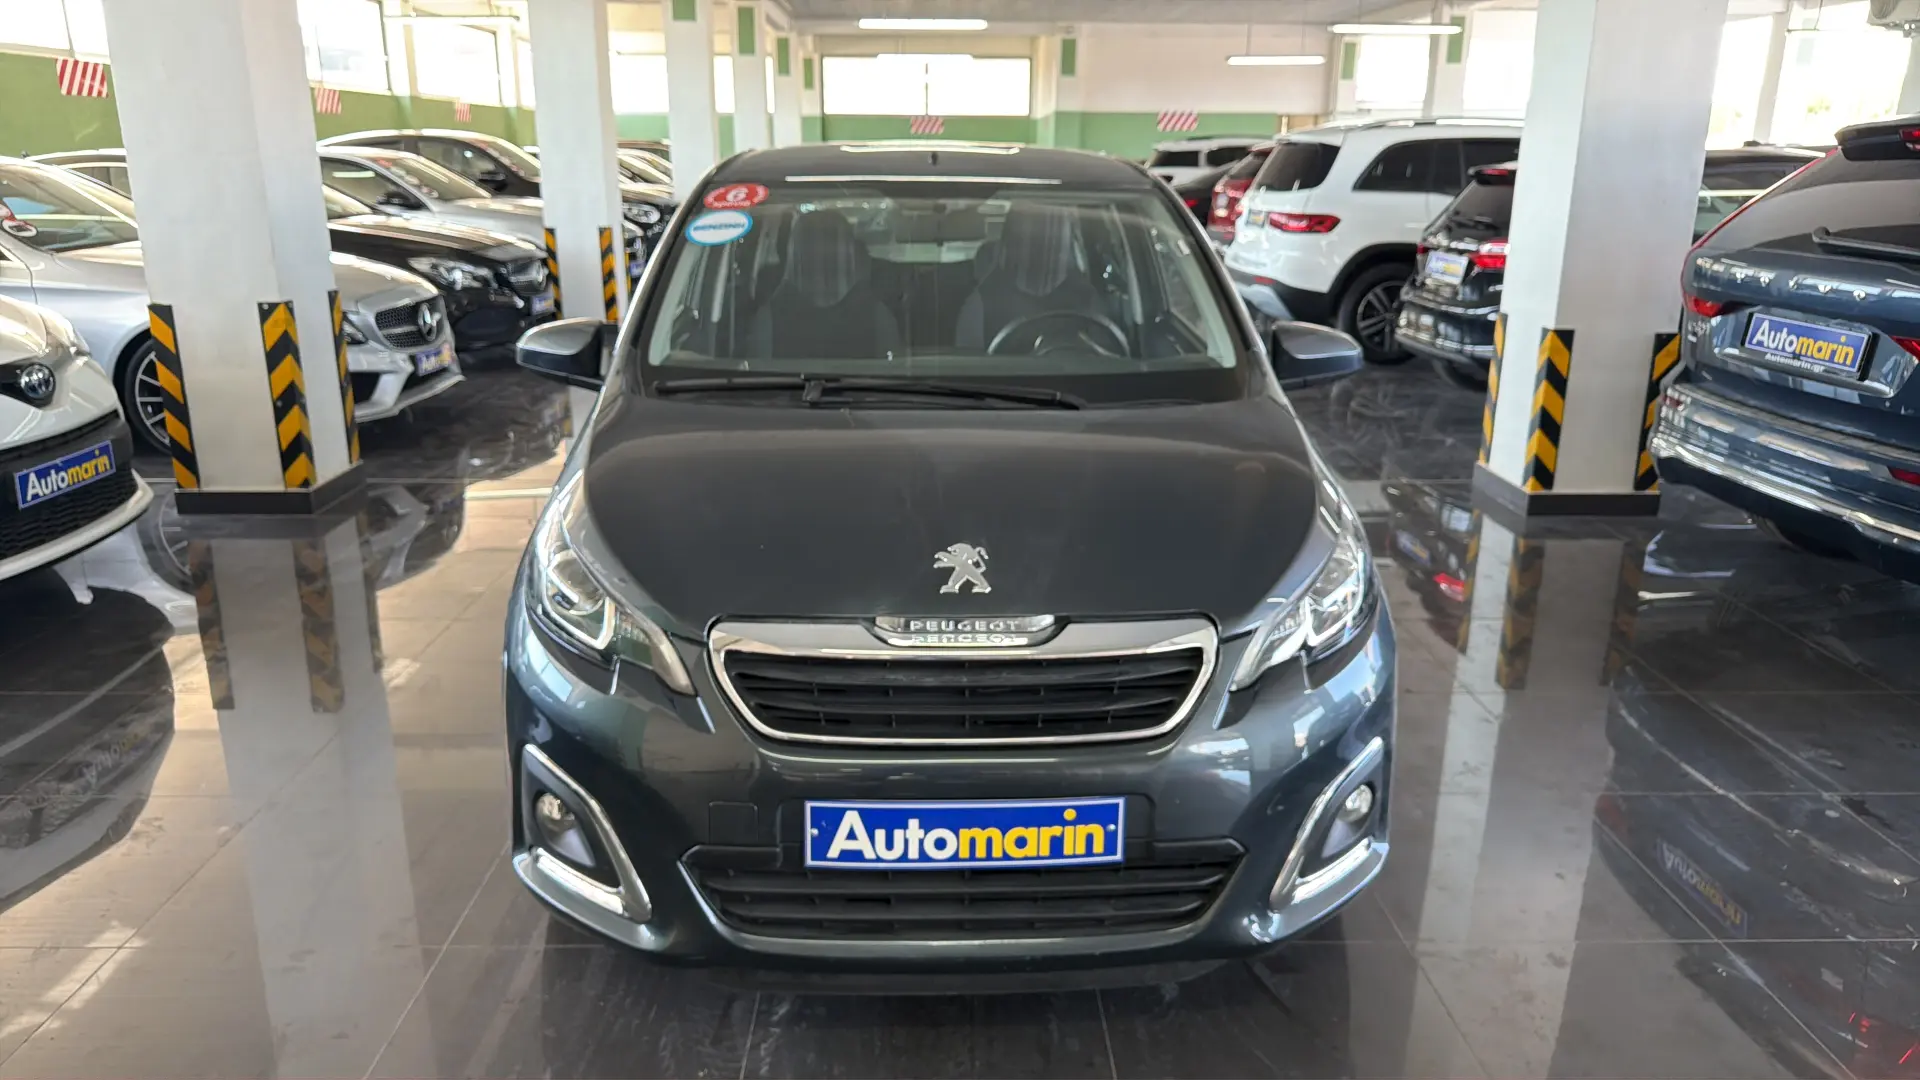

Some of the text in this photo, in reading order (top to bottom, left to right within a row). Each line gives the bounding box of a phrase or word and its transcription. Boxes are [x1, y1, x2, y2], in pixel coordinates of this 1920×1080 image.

[1752, 319, 1855, 366] Automarin
[1764, 352, 1826, 373] Automarin.gr
[27, 448, 111, 502] Automarin
[910, 620, 1018, 631] PEUGEOT
[827, 808, 1104, 860] Automarin
